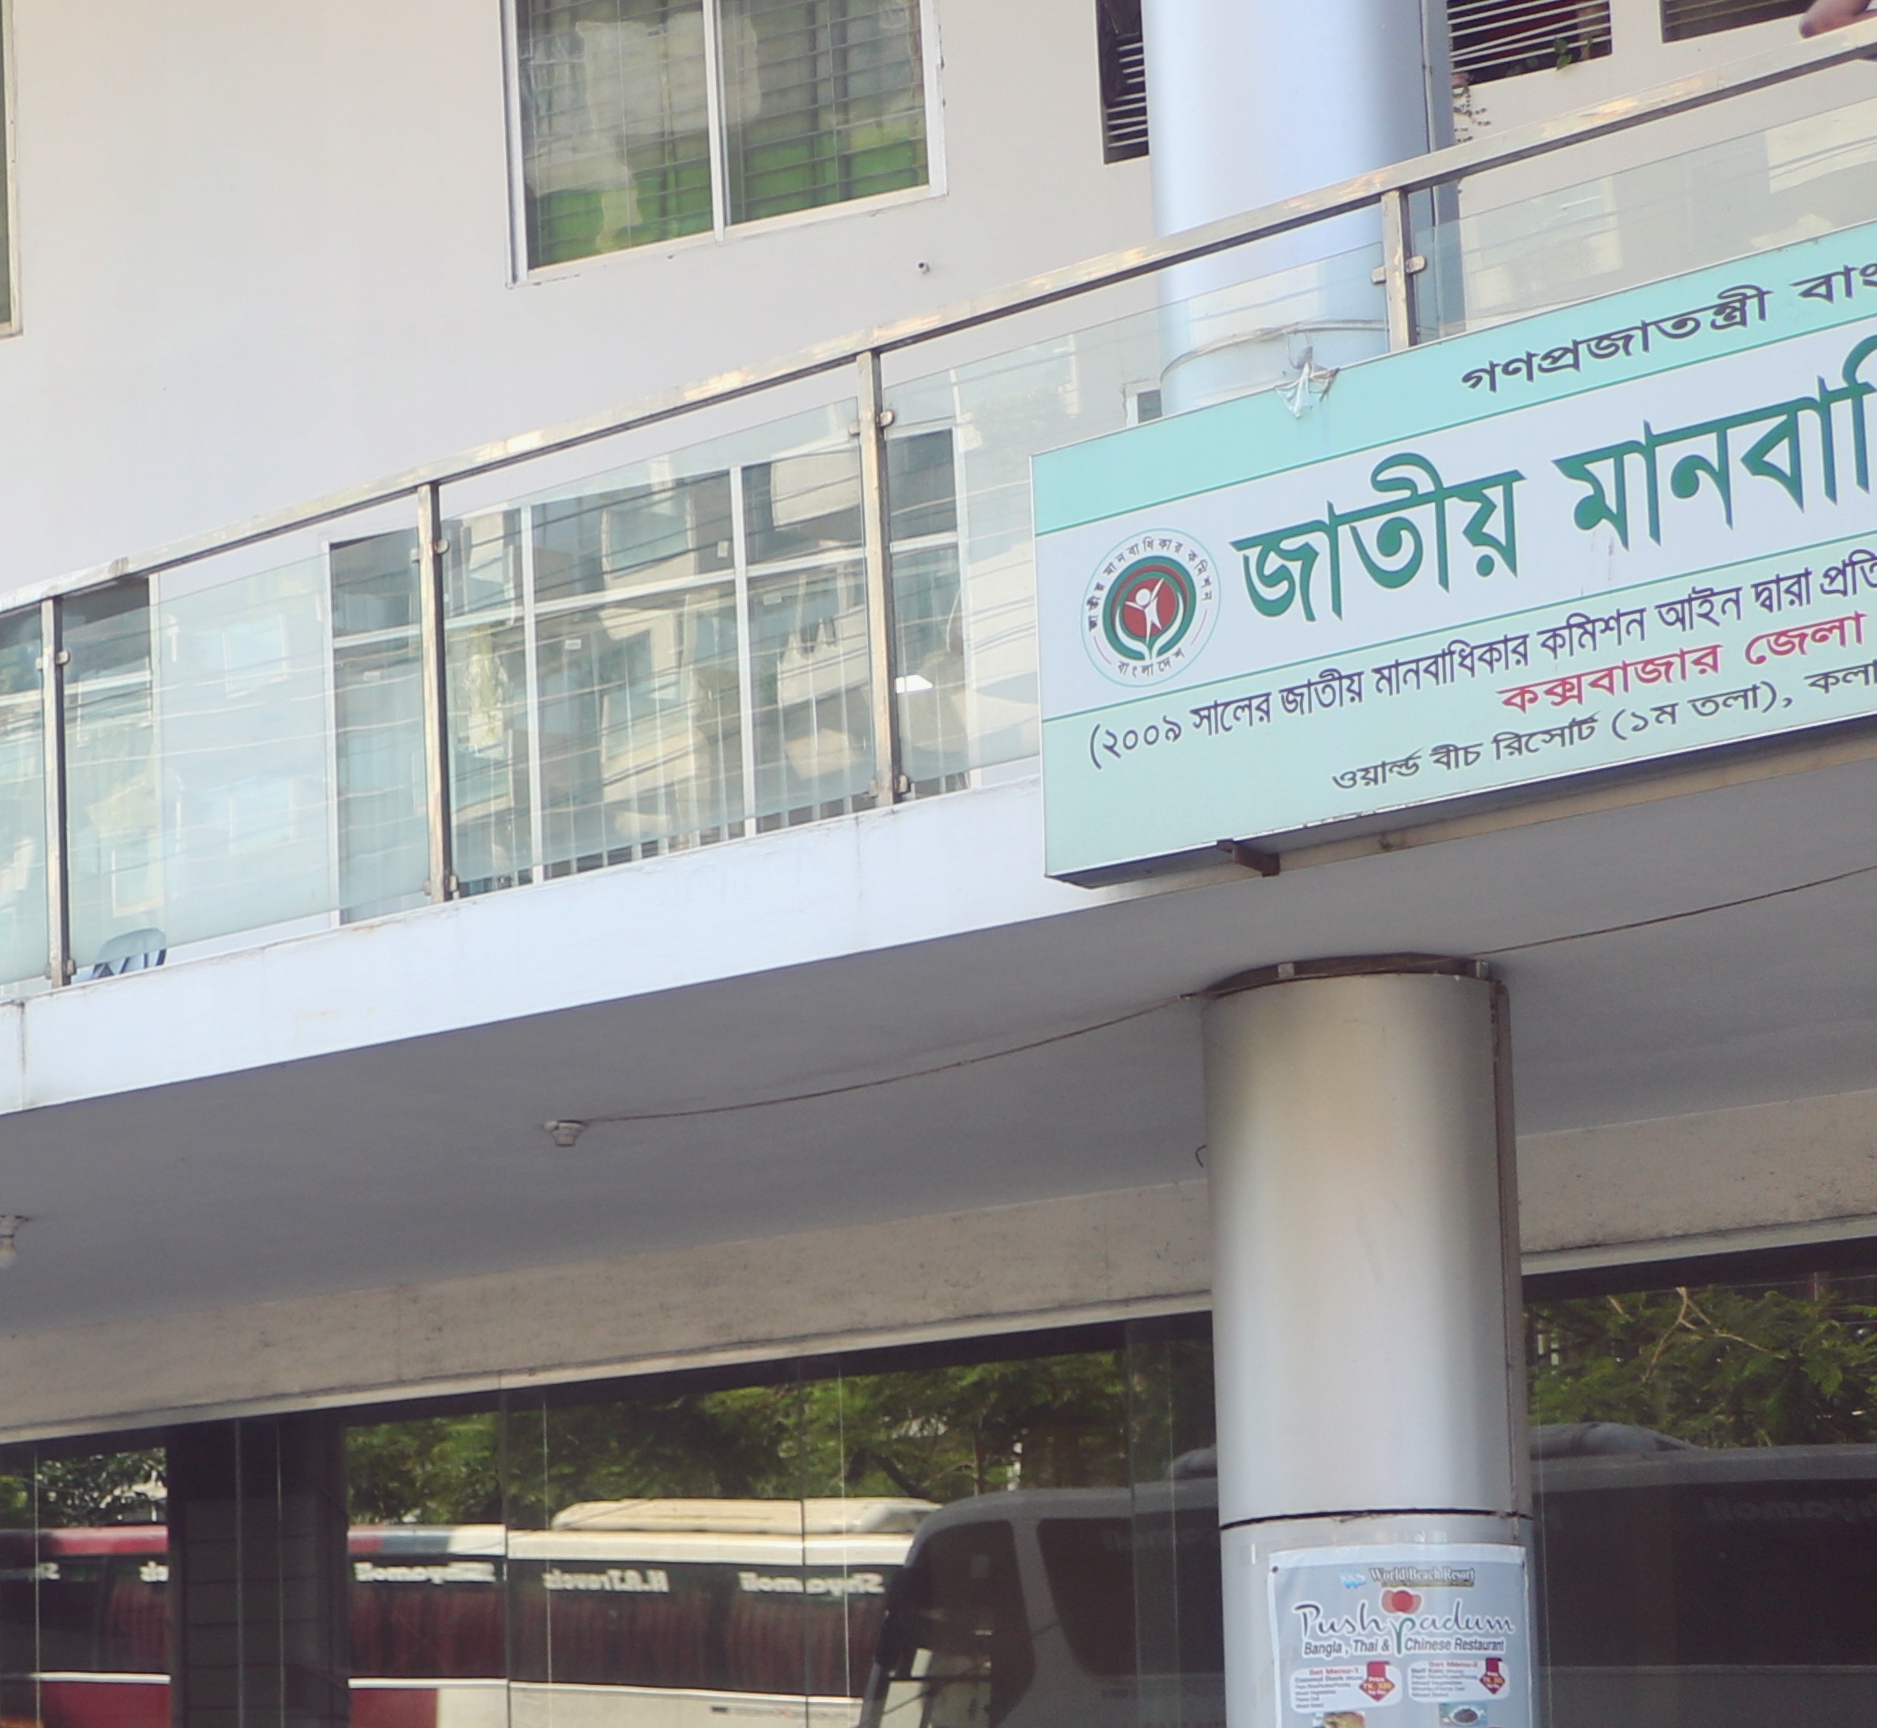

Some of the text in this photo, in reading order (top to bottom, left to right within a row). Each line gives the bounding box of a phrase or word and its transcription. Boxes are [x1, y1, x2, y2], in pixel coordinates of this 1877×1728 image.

[1231, 451, 1527, 624] জাতীয়
[1189, 691, 1272, 737] সালের
[1278, 667, 1364, 717] জাতীয়
[1371, 639, 1530, 697] মানবাধিকার
[1537, 613, 1647, 661] কমিশন
[1654, 585, 1744, 633] আইন
[1750, 566, 1813, 613] দ্বারা
[1496, 610, 1868, 714] কক্সবাজার জেলা
[1429, 742, 1484, 771] বীচ
[1492, 710, 1602, 762] রিসোর্ট
[1369, 1567, 1476, 1581] World Beach Resort
[1353, 1639, 1378, 1651] Thai
[1404, 1638, 1452, 1651] Chinese
[1454, 1637, 1505, 1651] Restaurant
